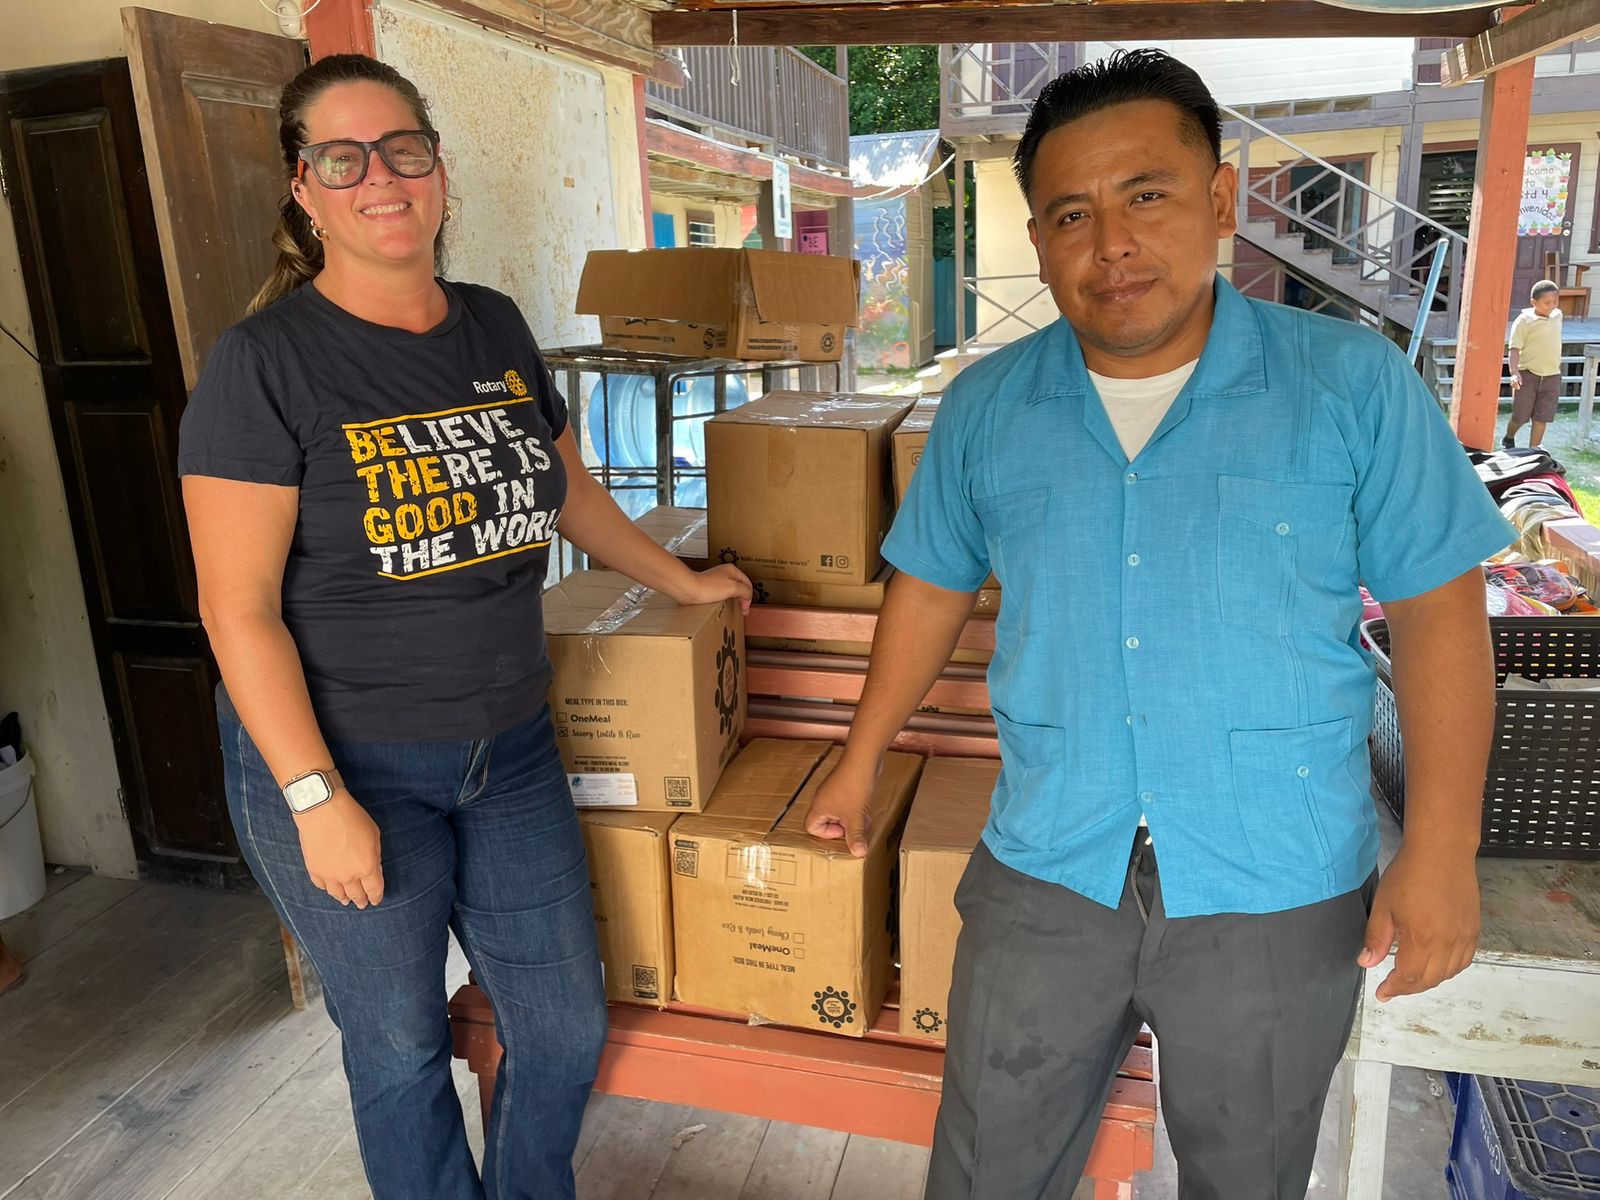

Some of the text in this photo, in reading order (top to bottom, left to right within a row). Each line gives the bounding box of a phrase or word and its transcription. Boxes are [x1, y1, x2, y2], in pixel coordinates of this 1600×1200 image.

[1525, 166, 1554, 176] lcome
[1525, 178, 1536, 188] to
[1541, 189, 1549, 199] 4
[1519, 205, 1557, 222] nvenidos
[472, 380, 507, 394] Rotary
[345, 408, 524, 464] BELIEVE
[356, 437, 551, 503] THERE IS
[363, 477, 535, 545] GOOD IN
[370, 508, 561, 574] THE WORL
[565, 698, 580, 706] MEAL
[581, 698, 595, 706] TYPE
[596, 698, 602, 706] IN
[603, 698, 615, 706] THIS
[571, 714, 611, 723] OneMeal
[749, 942, 790, 955] OneMeal
[746, 959, 758, 967] THIS
[758, 960, 765, 968] IN
[766, 961, 780, 971] TYPE
[780, 964, 796, 973] MEAL
